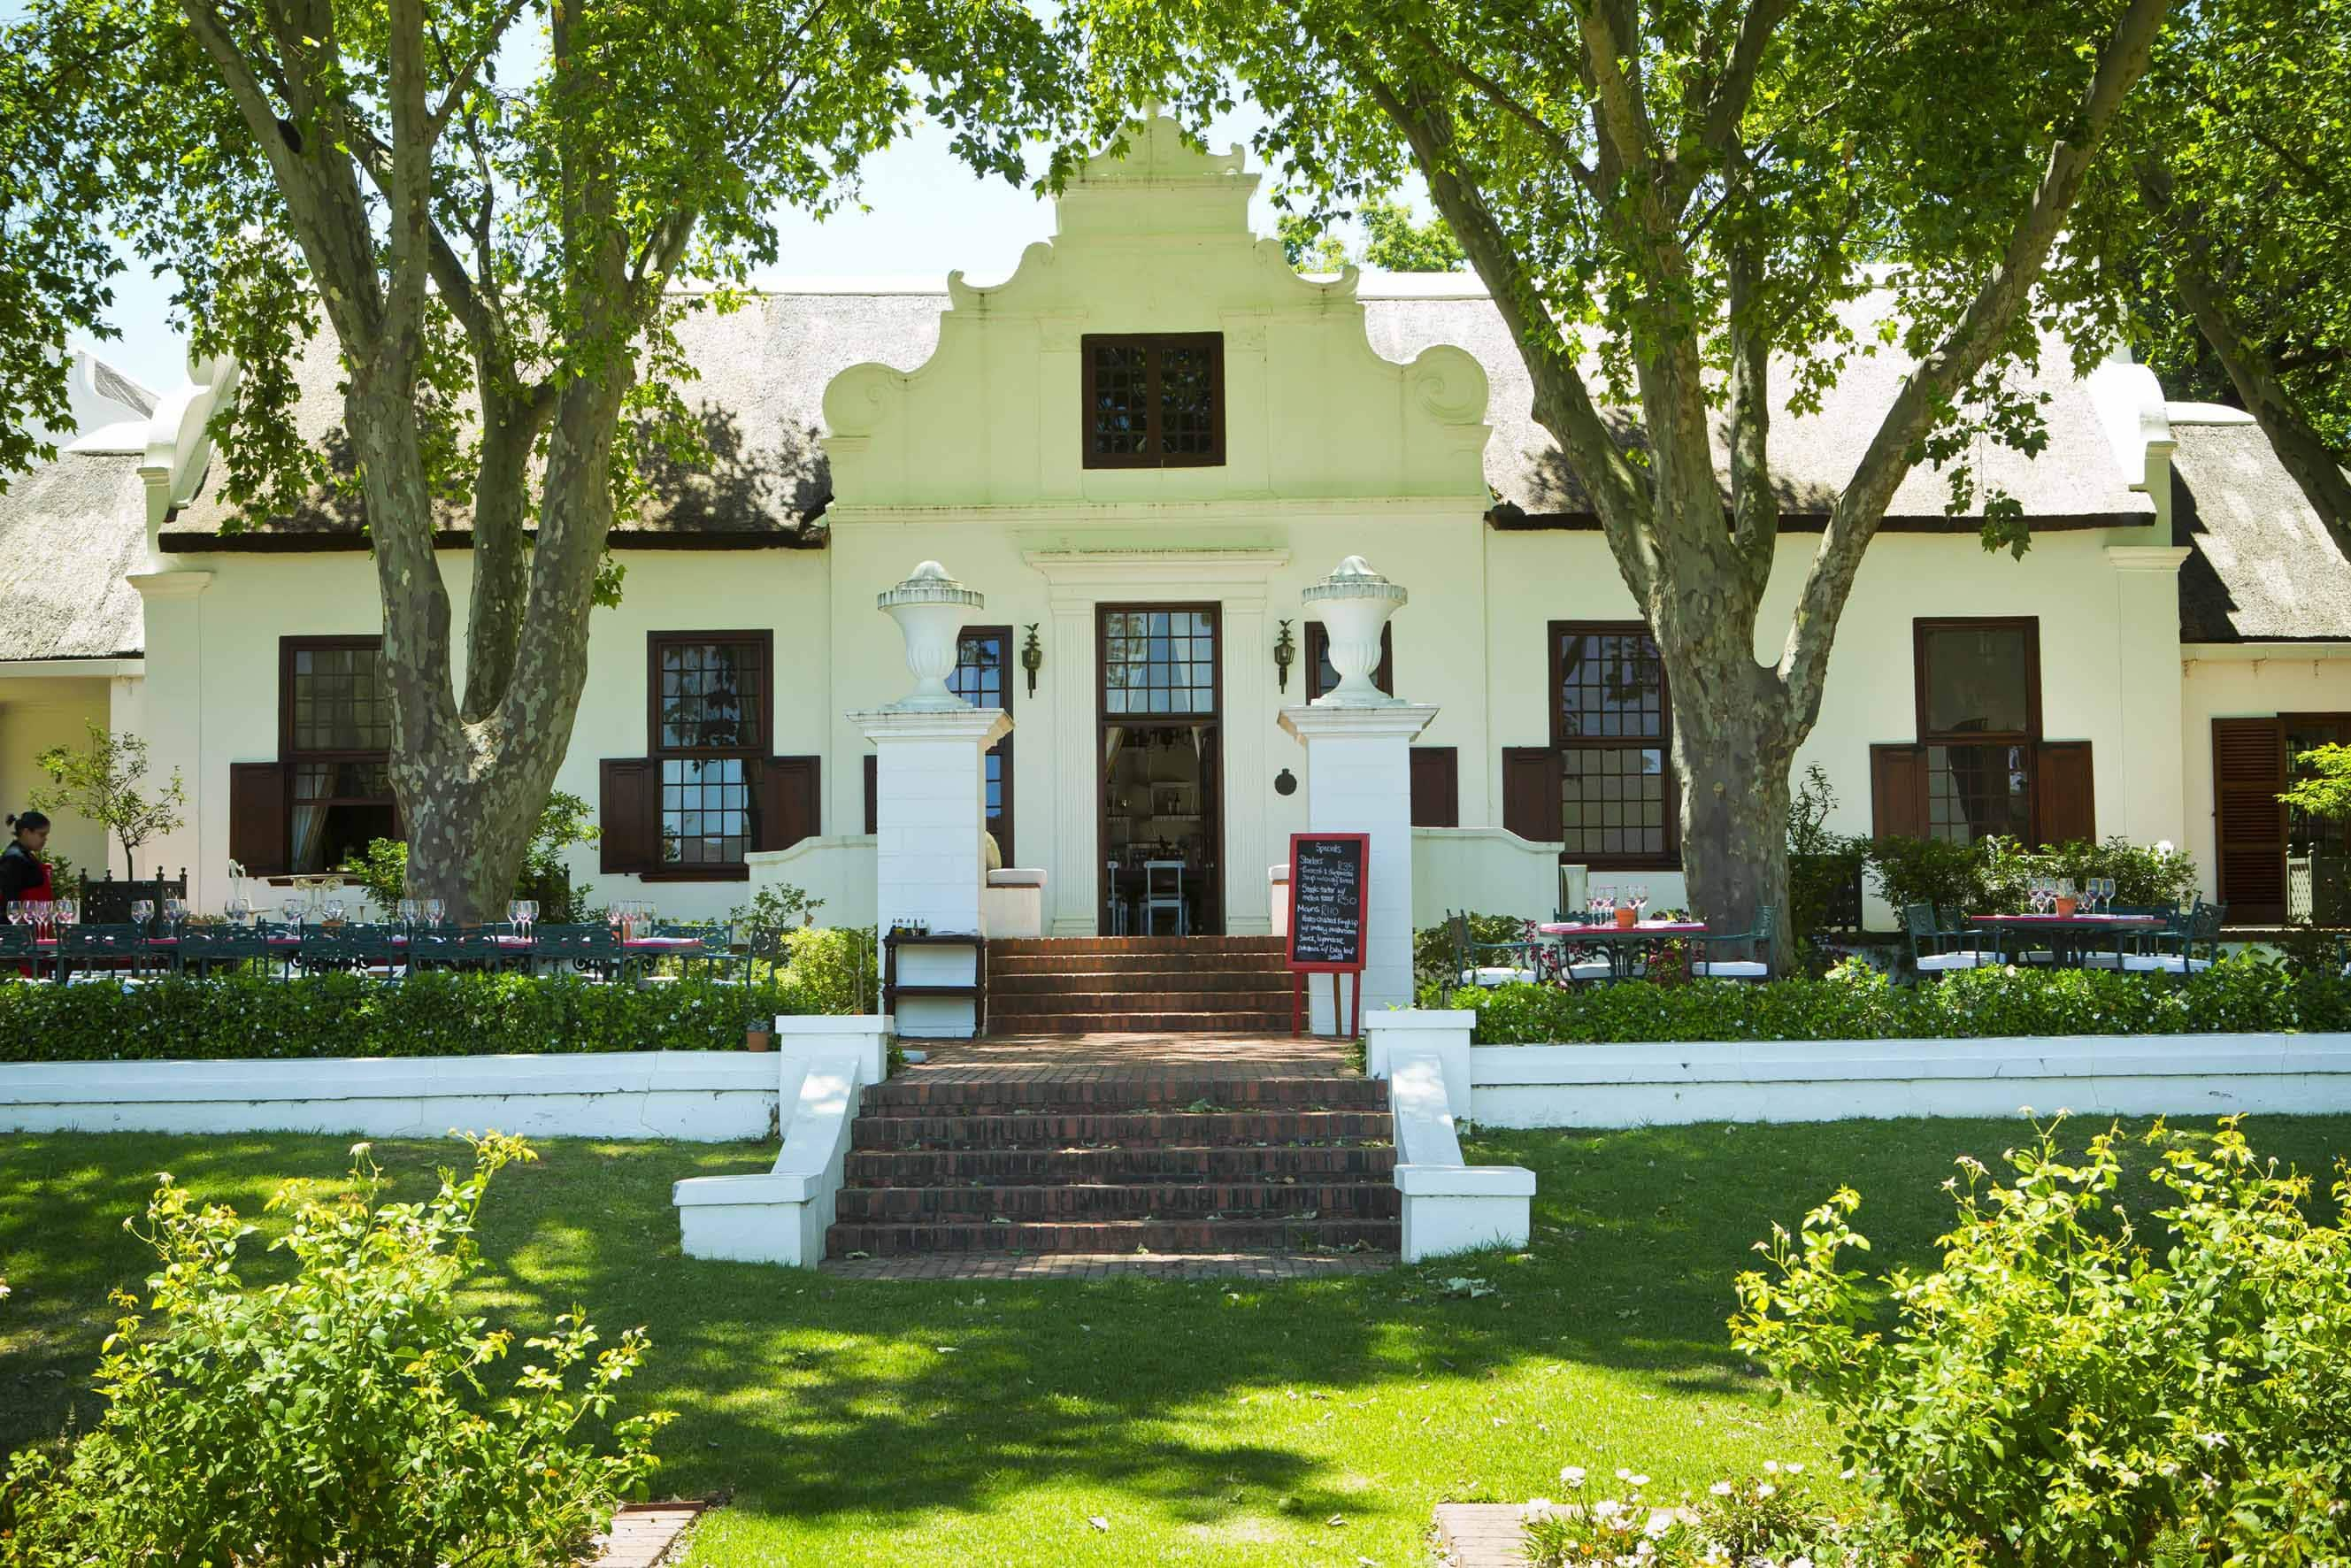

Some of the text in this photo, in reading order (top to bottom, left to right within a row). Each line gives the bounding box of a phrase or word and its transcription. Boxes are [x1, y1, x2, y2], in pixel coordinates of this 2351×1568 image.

[1316, 842, 1342, 854] Specials
[1337, 894, 1357, 905] R50
[1321, 904, 1339, 917] R110
